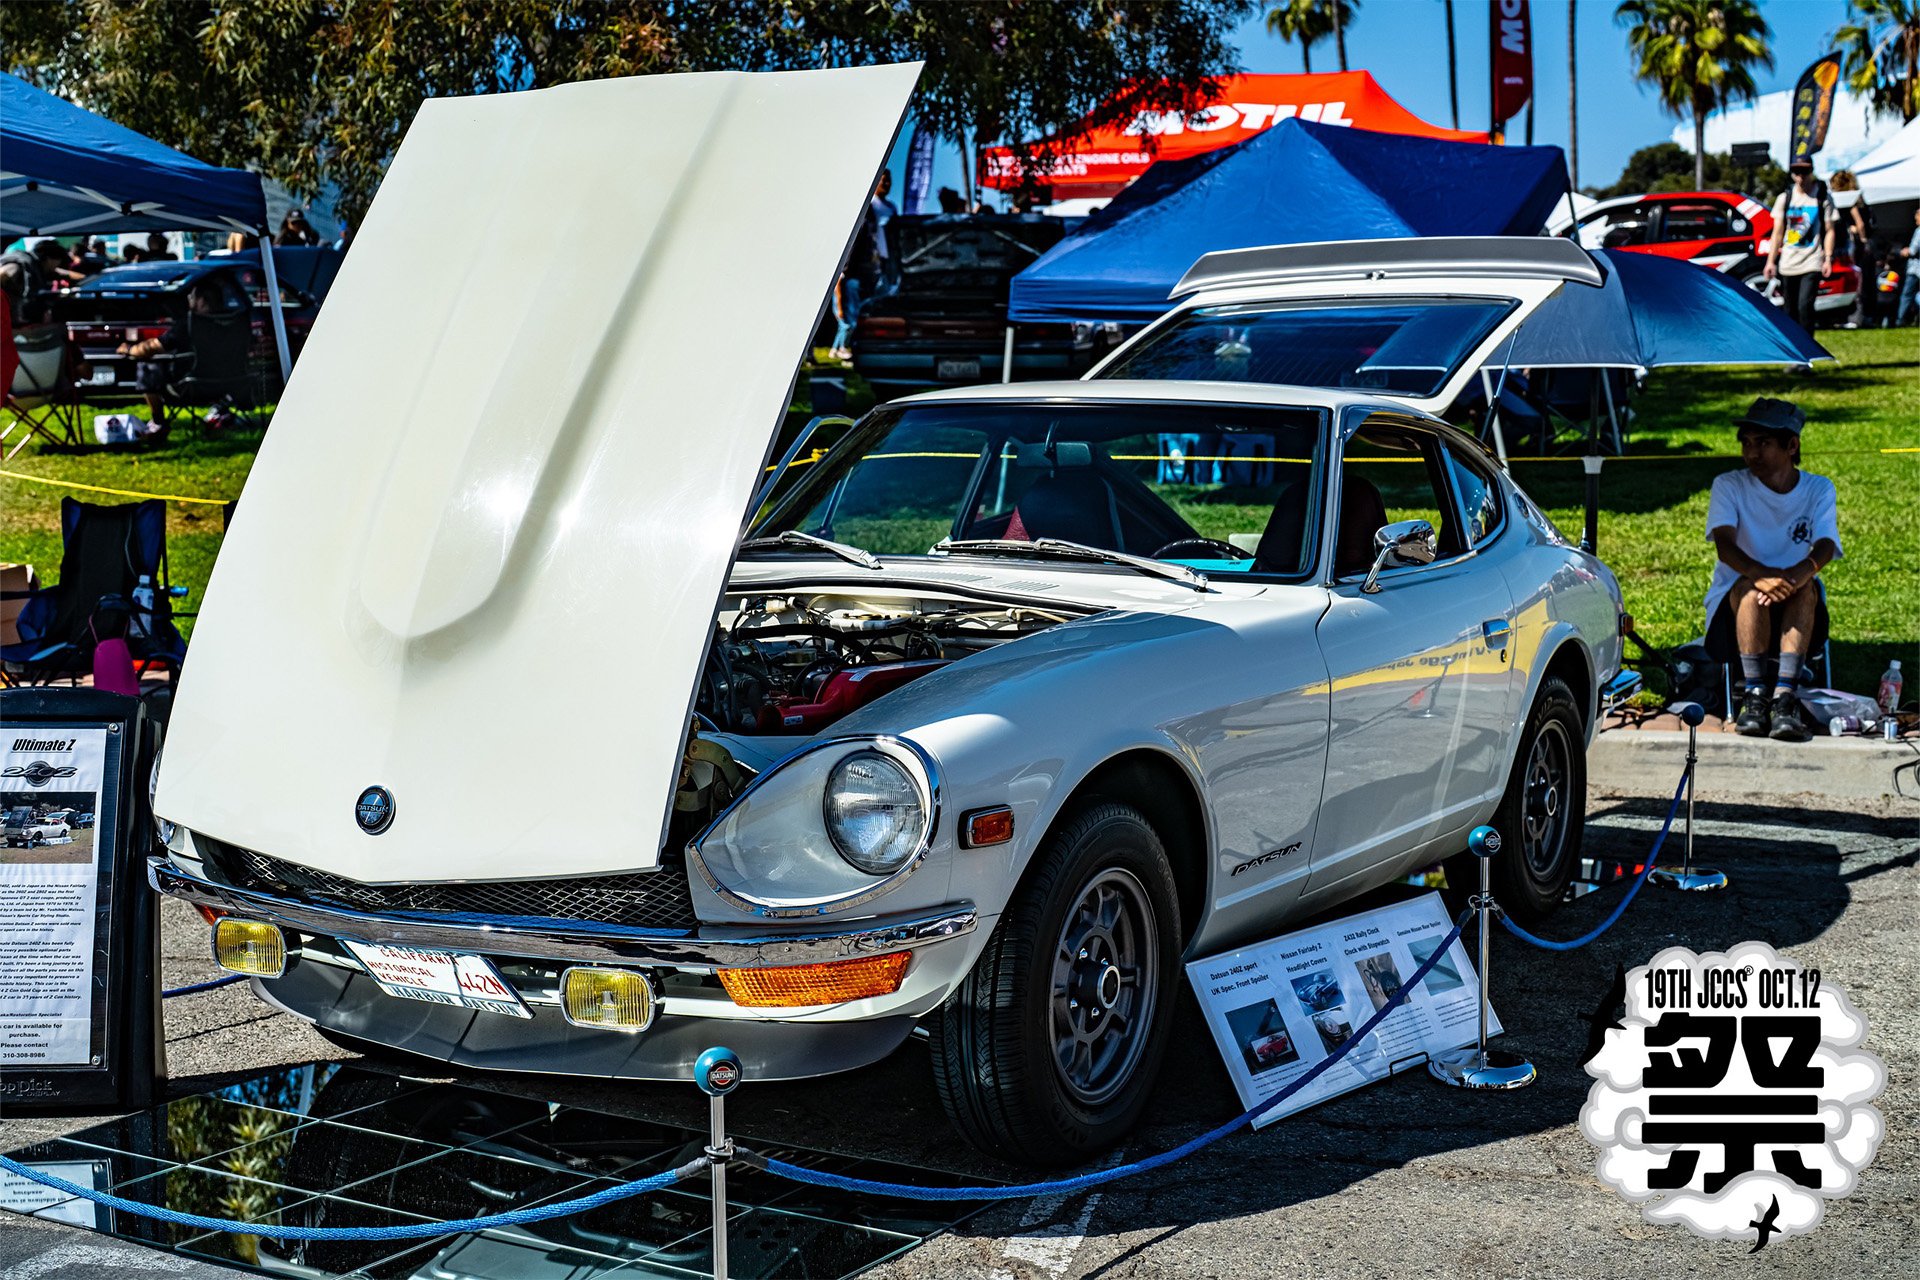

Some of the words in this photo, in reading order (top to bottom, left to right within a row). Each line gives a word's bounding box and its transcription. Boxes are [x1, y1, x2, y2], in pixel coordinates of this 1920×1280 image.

[1121, 102, 1354, 137] MOTUL
[1121, 152, 1150, 164] OILS
[12, 739, 66, 751] Ultimate
[66, 739, 76, 751] Z
[357, 804, 389, 812] DATSUN
[1231, 841, 1302, 876] DATSUN
[1356, 930, 1368, 939] Rally
[1368, 938, 1390, 949] Stopwatch
[380, 948, 460, 966] CALIFORNIA
[1280, 951, 1298, 960] Nissan
[1298, 945, 1318, 957] Fairlady
[367, 960, 436, 978] HISTORICAL
[1210, 971, 1230, 980] Datsun
[1229, 966, 1243, 975] 240Z
[1243, 962, 1258, 973] sport
[1286, 961, 1310, 973] Headlight
[1311, 957, 1327, 966] Covers
[379, 972, 428, 986] VEHICLE
[1211, 987, 1221, 995] UK
[1221, 985, 1236, 994] Spec.
[1236, 980, 1250, 988] Front
[1251, 974, 1269, 984] Spoiler
[393, 985, 455, 1004] HARBOR
[463, 999, 522, 1017] DATSUN
